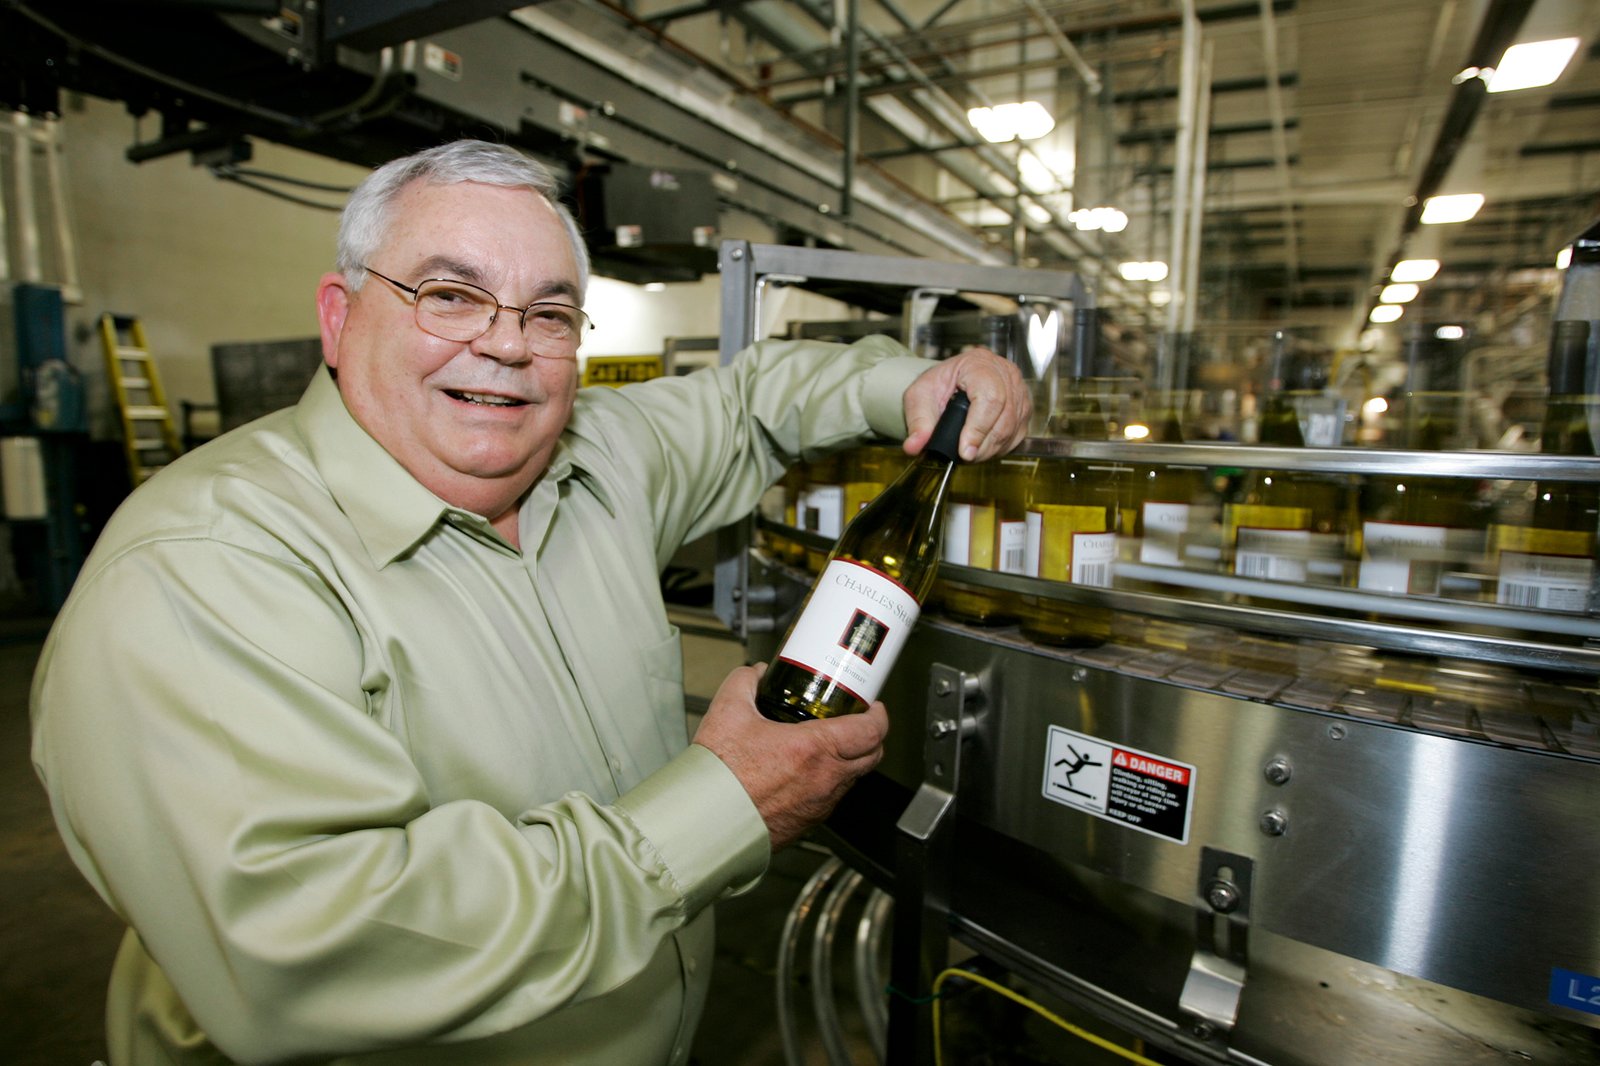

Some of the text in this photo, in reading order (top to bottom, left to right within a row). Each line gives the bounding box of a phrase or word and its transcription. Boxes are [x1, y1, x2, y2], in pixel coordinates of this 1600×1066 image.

[835, 573, 895, 609] CHARLES
[825, 654, 867, 684] Chadonnay
[1129, 757, 1183, 782] DANGER
